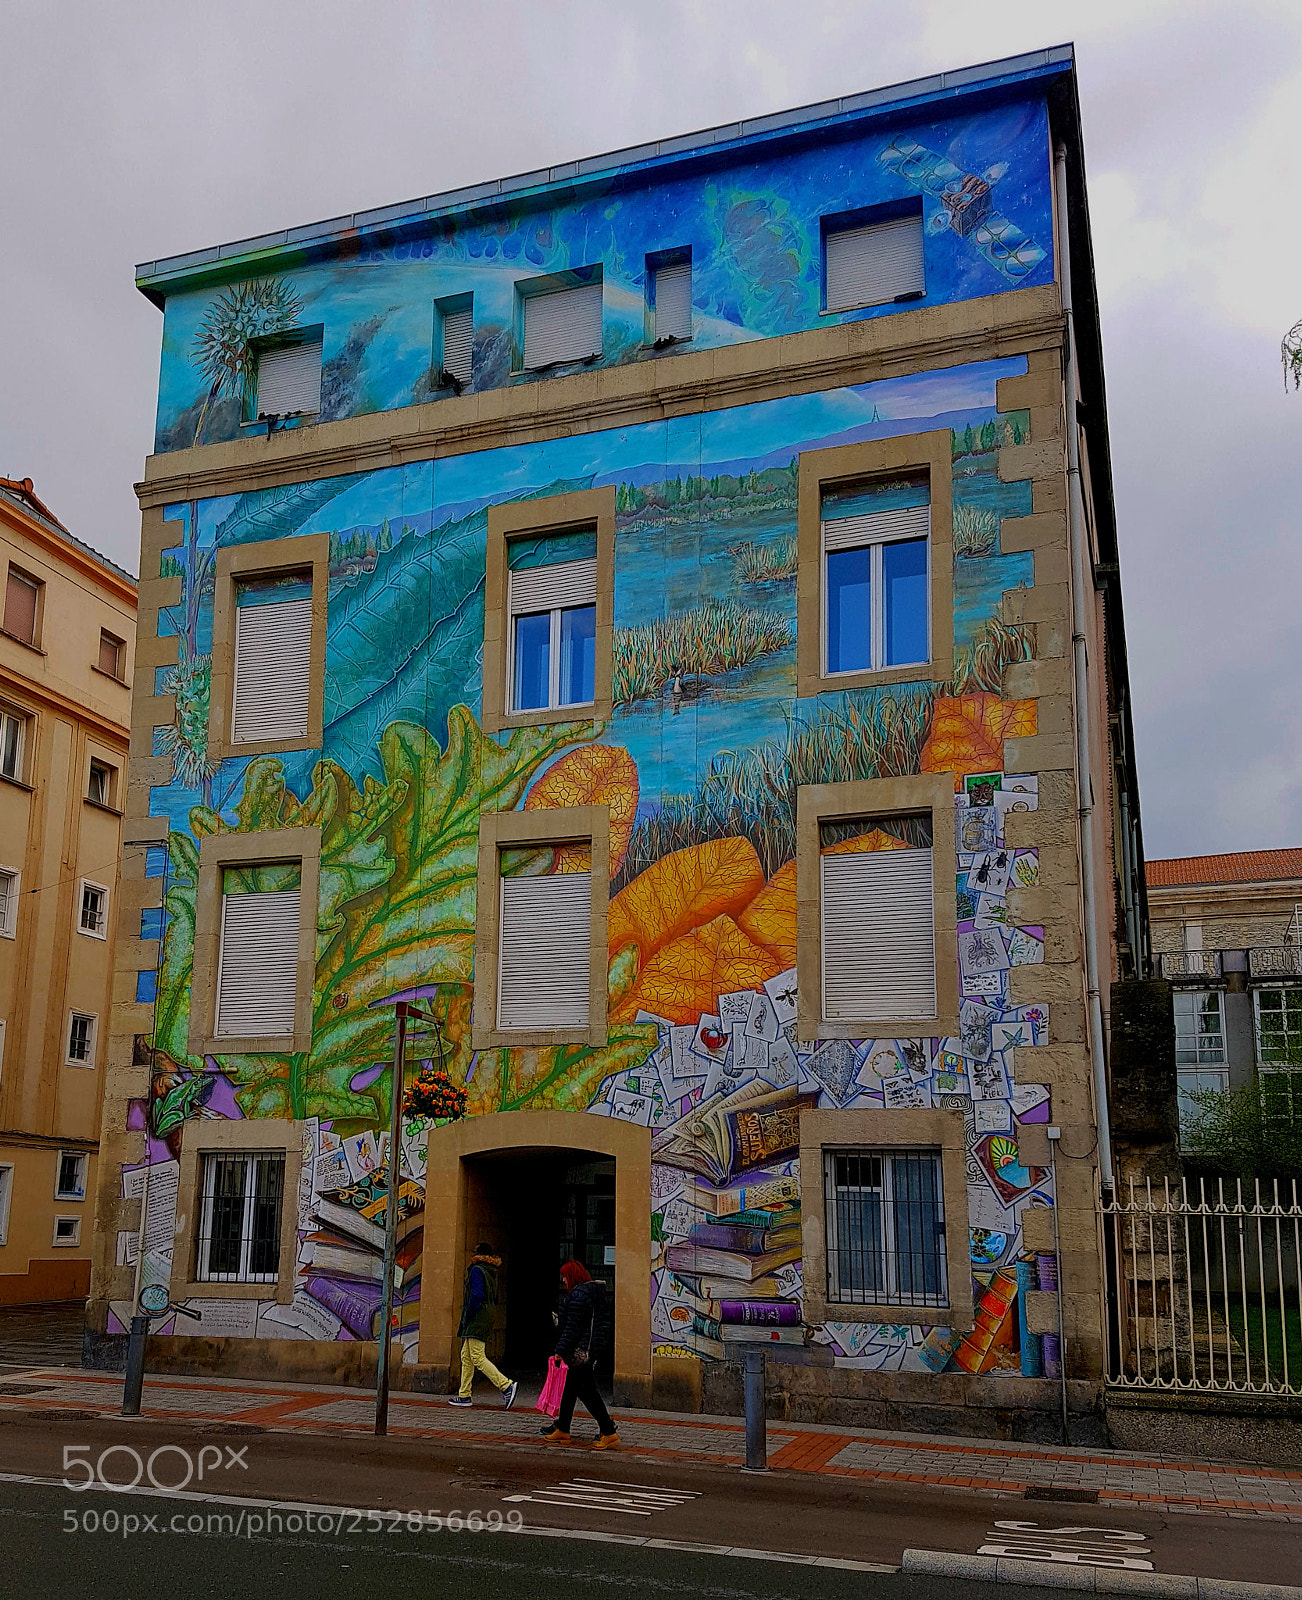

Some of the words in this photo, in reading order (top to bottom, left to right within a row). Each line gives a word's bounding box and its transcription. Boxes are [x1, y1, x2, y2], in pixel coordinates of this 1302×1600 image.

[745, 1112, 766, 1161] SUEÑOS
[501, 1477, 703, 1516] TAXI
[976, 1520, 1155, 1571] BUS
